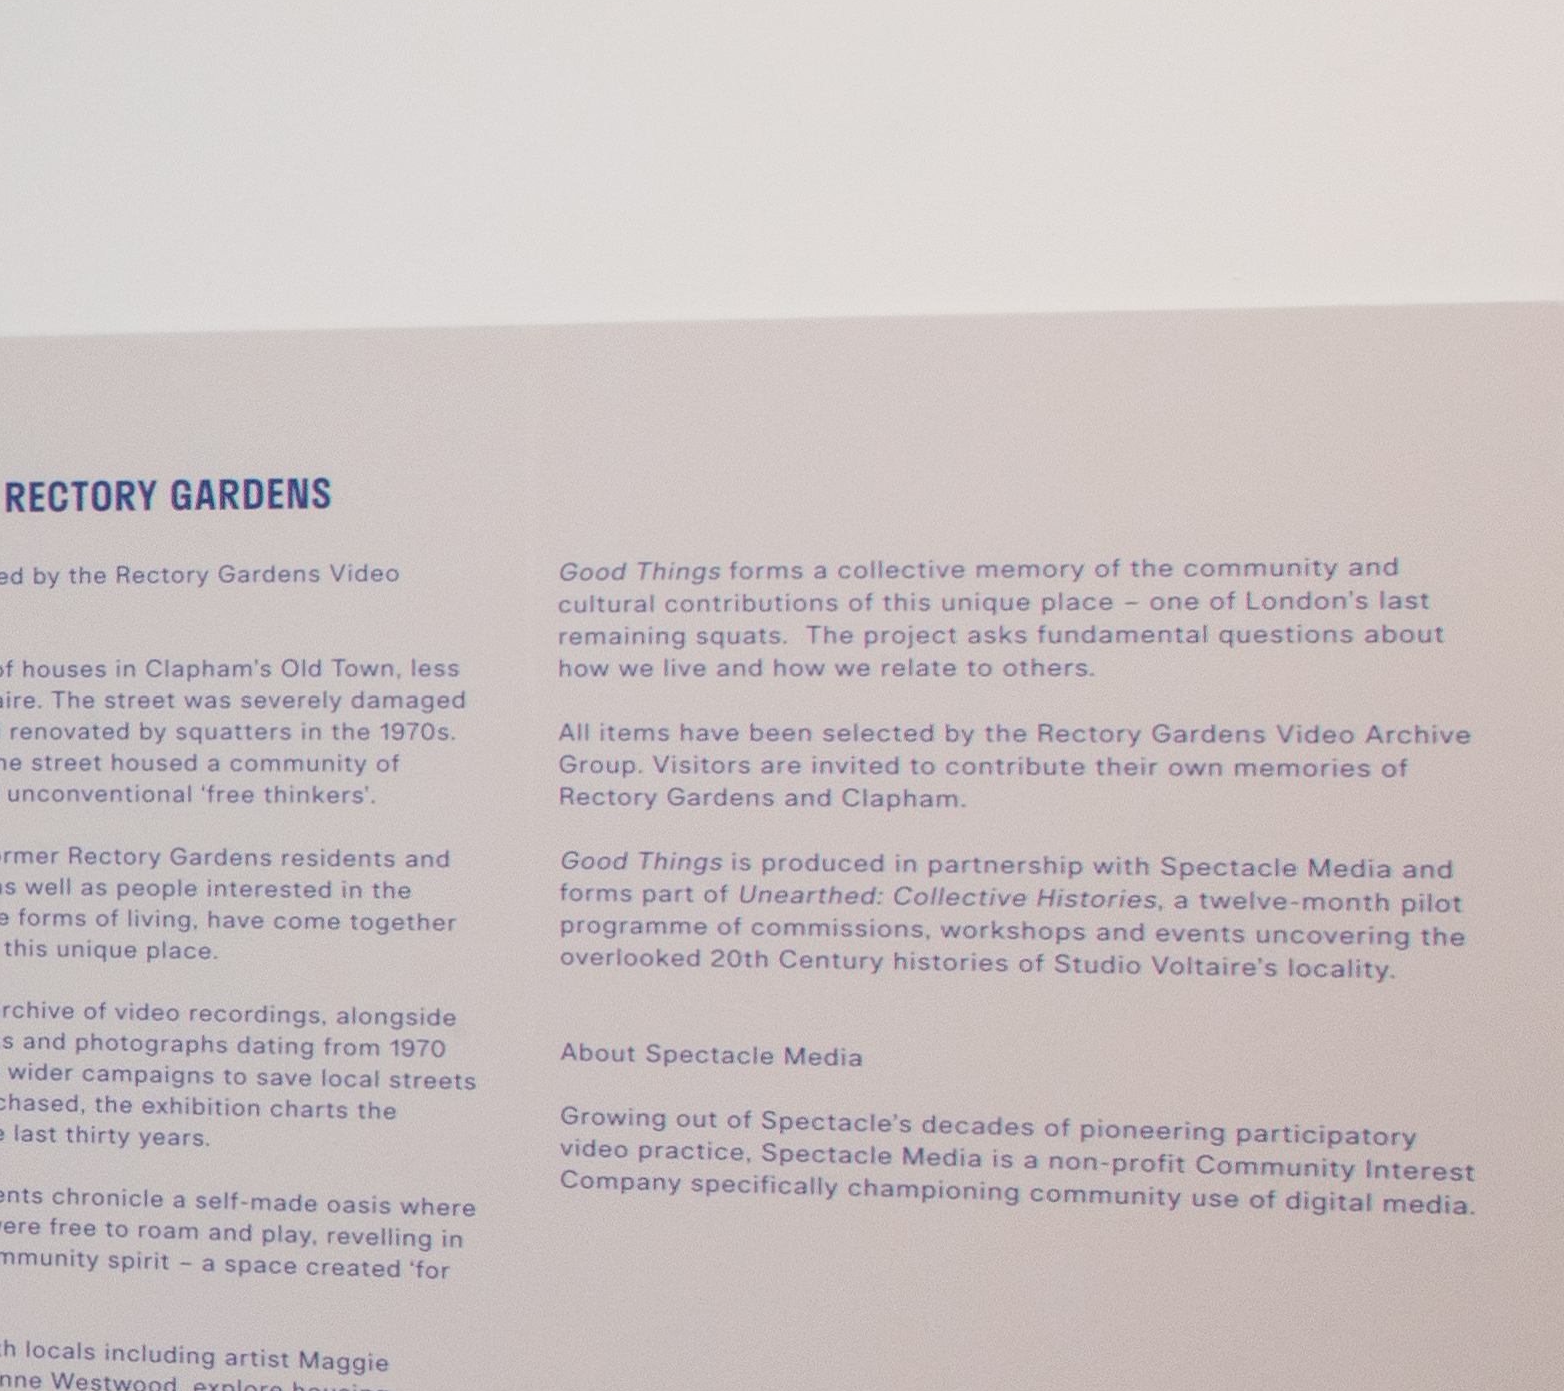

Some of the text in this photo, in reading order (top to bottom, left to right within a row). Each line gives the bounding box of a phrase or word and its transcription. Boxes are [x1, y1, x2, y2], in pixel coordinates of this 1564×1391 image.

[4, 478, 159, 514] RECTORY
[169, 475, 334, 513] GARDENS
[32, 565, 61, 590] by
[67, 565, 108, 586] the
[115, 564, 211, 589] Rectory
[217, 563, 322, 585] Gardens
[328, 562, 401, 584] Video
[559, 785, 967, 813] Rectory Gardens and Clapham.
[67, 844, 162, 870] Rectory
[169, 845, 273, 868] Gardens
[280, 847, 397, 869] residents
[404, 848, 452, 870] and
[560, 849, 1455, 882] Good Things is produced in partnership with Spectacle Media and
[24, 877, 72, 897] well
[80, 881, 108, 897] as
[116, 878, 199, 901] people
[207, 880, 333, 900] interested
[341, 884, 364, 899] in
[371, 880, 413, 901] the
[559, 881, 1464, 917] forms part of Unearthed: Collective Histories, a twelve-month pilot
[18, 906, 88, 928] forms
[95, 908, 119, 928] of
[127, 908, 199, 934] living,
[207, 909, 266, 931] have
[272, 915, 342, 932] come
[349, 912, 458, 937] together
[559, 916, 1467, 952] programme of commissions, workshops and events uncovering the
[3, 938, 49, 959] this
[56, 939, 139, 964] unique
[146, 940, 219, 964] place.
[559, 948, 1397, 984] overlooked 20th Century histories of Studio Voltaire’s locality.
[559, 1041, 864, 1068] About Spectacle Media
